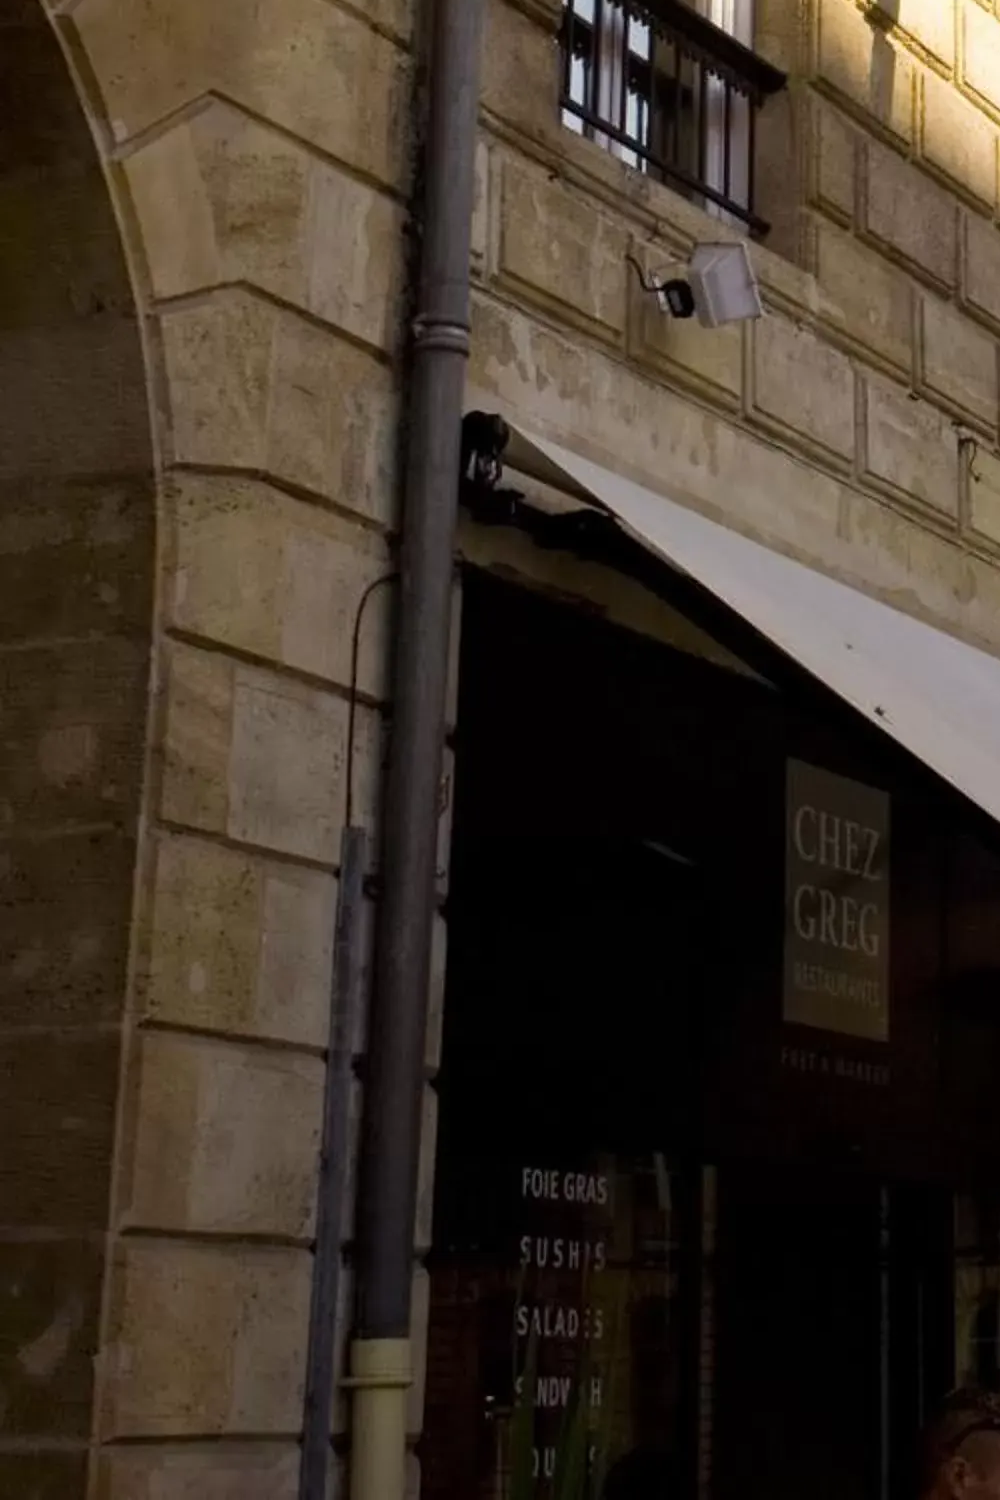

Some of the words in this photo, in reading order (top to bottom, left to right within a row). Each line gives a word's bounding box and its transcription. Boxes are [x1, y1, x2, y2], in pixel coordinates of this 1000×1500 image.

[794, 805, 882, 881] CHEZ
[793, 884, 880, 957] GREG
[521, 1167, 559, 1199] FOIE
[563, 1172, 608, 1205] GRAS
